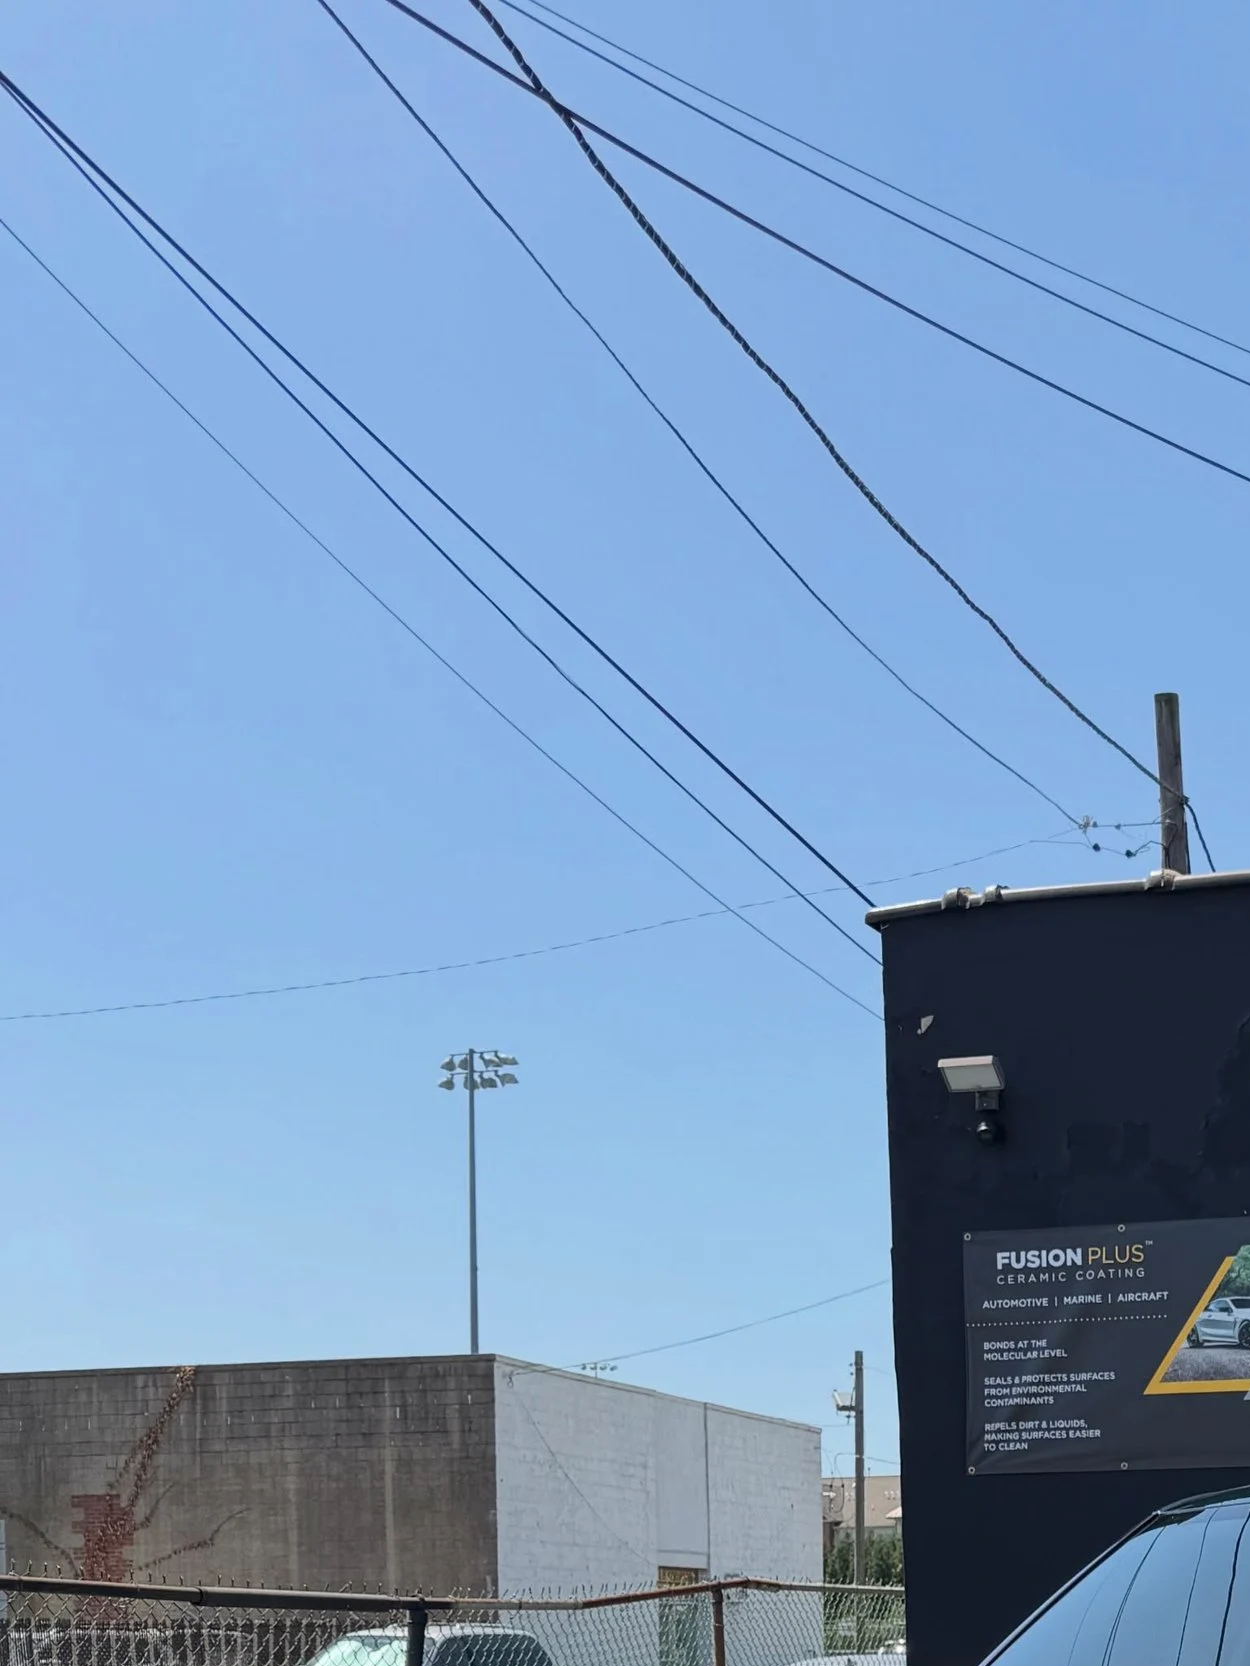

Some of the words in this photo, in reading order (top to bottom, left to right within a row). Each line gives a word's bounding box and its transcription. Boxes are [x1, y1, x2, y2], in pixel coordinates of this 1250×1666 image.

[996, 1248, 1082, 1270] FUSION
[1088, 1244, 1144, 1265] PLUS
[996, 1272, 1067, 1285] CERAMIC
[1075, 1268, 1145, 1281] COATING
[982, 1298, 1049, 1309] AUTOMOTIVE
[1063, 1294, 1102, 1305] MARINE
[1117, 1291, 1168, 1303] AIRCRAFT
[983, 1341, 1015, 1350] BONDS
[1017, 1341, 1029, 1349] AT
[1031, 1339, 1047, 1348] THE
[983, 1351, 1038, 1361] MOLECULAR
[1039, 1349, 1067, 1358] LEVEL
[984, 1376, 1012, 1385] SEALS
[1014, 1376, 1020, 1384] &
[1021, 1373, 1068, 1383] PROTECTS
[1069, 1371, 1115, 1381] SURFACES
[984, 1387, 1010, 1396] FROM
[1012, 1384, 1087, 1395] ENVIRONMENTAL
[984, 1396, 1054, 1407] CONTAMINANTS
[985, 1422, 1017, 1431] REPELS
[1019, 1421, 1039, 1430] DIRT
[1041, 1421, 1048, 1429] &
[1049, 1419, 1088, 1430] LIQUIDS,
[984, 1432, 1019, 1441] MAKING
[1021, 1430, 1067, 1440] SURFACES
[1069, 1429, 1101, 1438] EASIER
[984, 1443, 996, 1451] TO
[998, 1442, 1028, 1451] CLEAN
